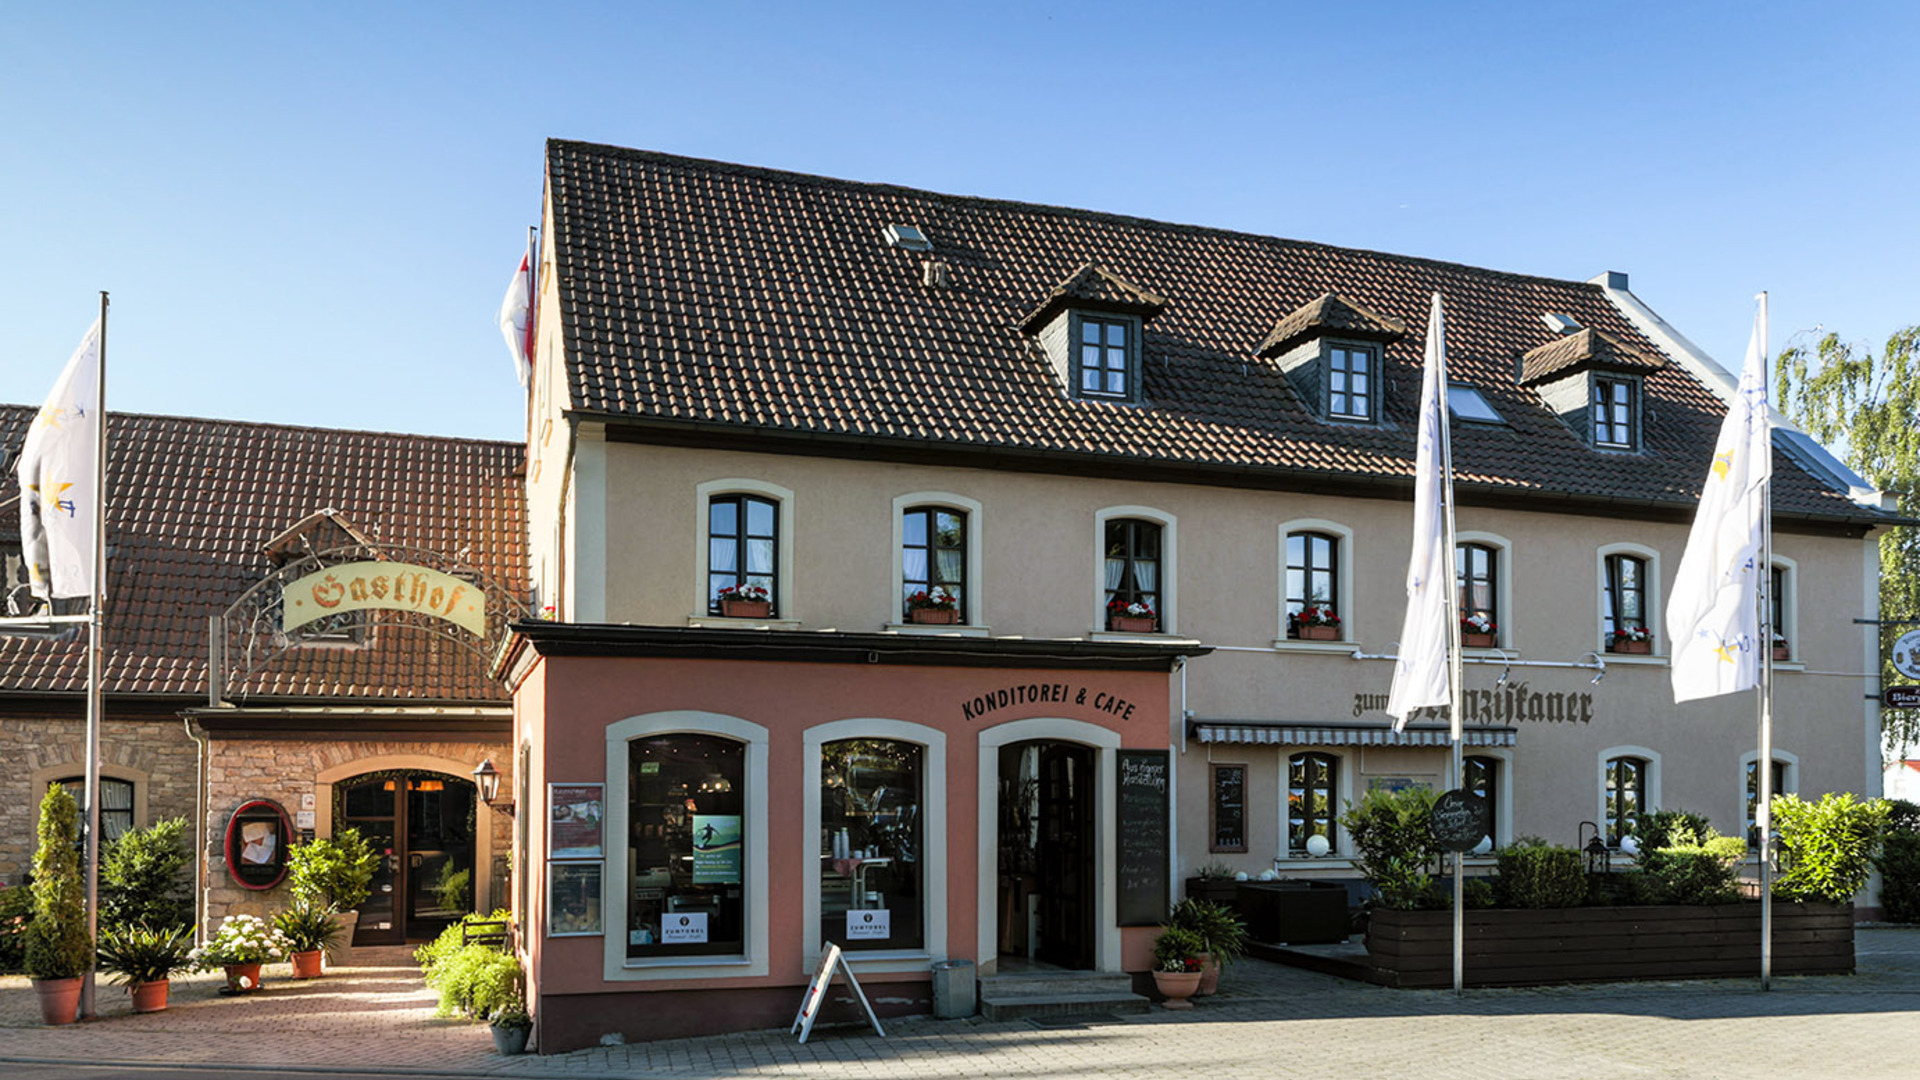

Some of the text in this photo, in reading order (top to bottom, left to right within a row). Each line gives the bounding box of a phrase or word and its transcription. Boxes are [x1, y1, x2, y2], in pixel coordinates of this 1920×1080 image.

[311, 570, 467, 616] Gasthof
[962, 684, 1136, 721] KONDITOREI & CAFE
[1352, 693, 1389, 717] zum
[1122, 758, 1138, 772] Aus
